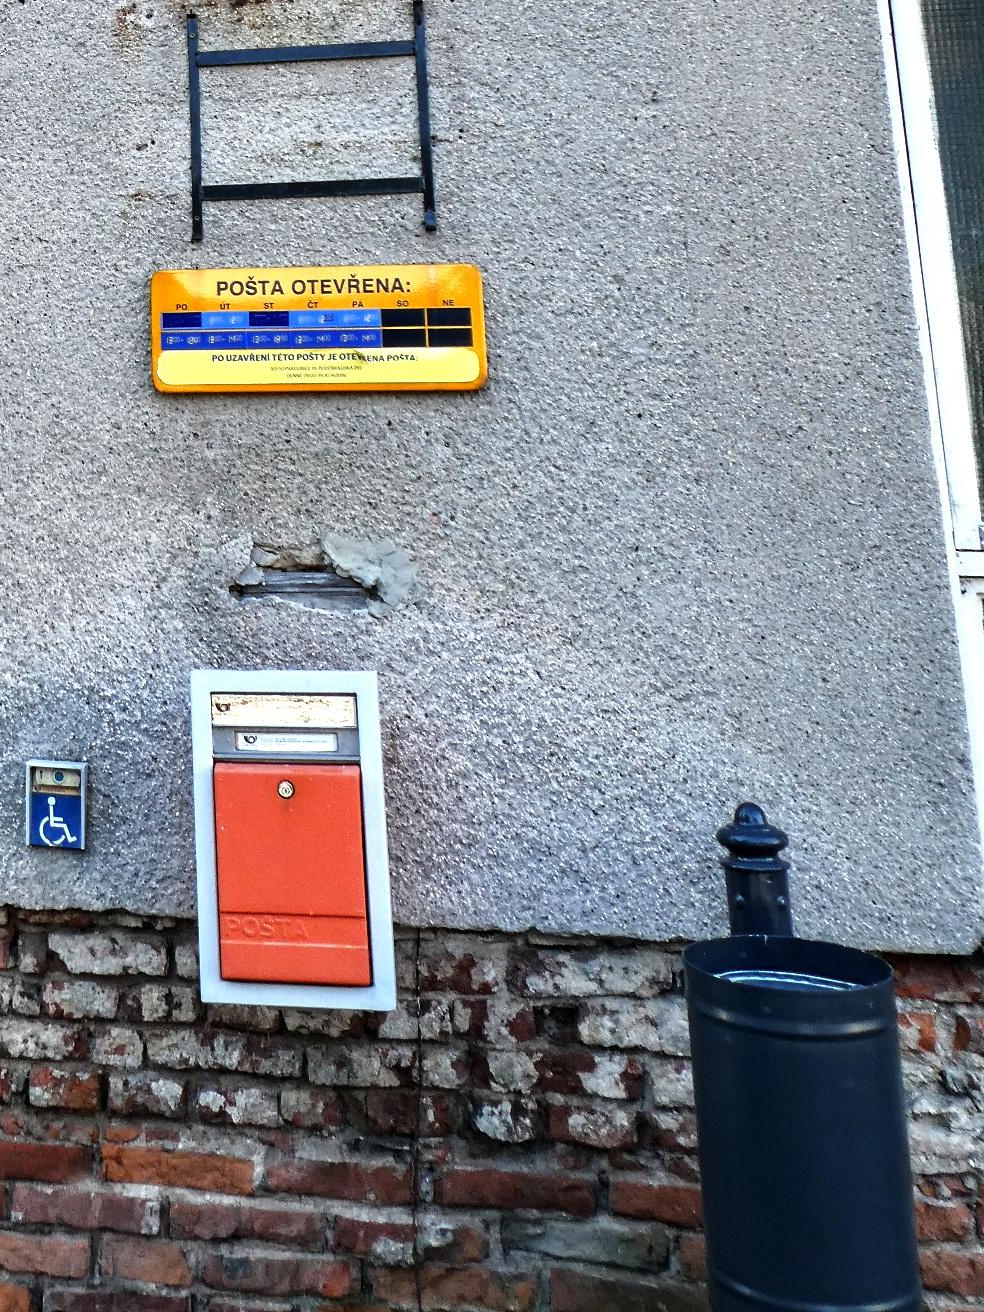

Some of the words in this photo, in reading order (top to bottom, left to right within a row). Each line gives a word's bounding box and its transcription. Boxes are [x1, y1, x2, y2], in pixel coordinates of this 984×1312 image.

[216, 275, 285, 297] POŠTA
[291, 273, 412, 296] OTEVŘENA:
[176, 303, 188, 311] PO
[263, 302, 275, 310] ST
[396, 299, 410, 308] SO
[442, 299, 455, 307] NE
[211, 354, 224, 362] PO
[226, 352, 270, 362] UZAVŘENÍ
[296, 351, 326, 361] POŠTY
[327, 353, 337, 361] JE
